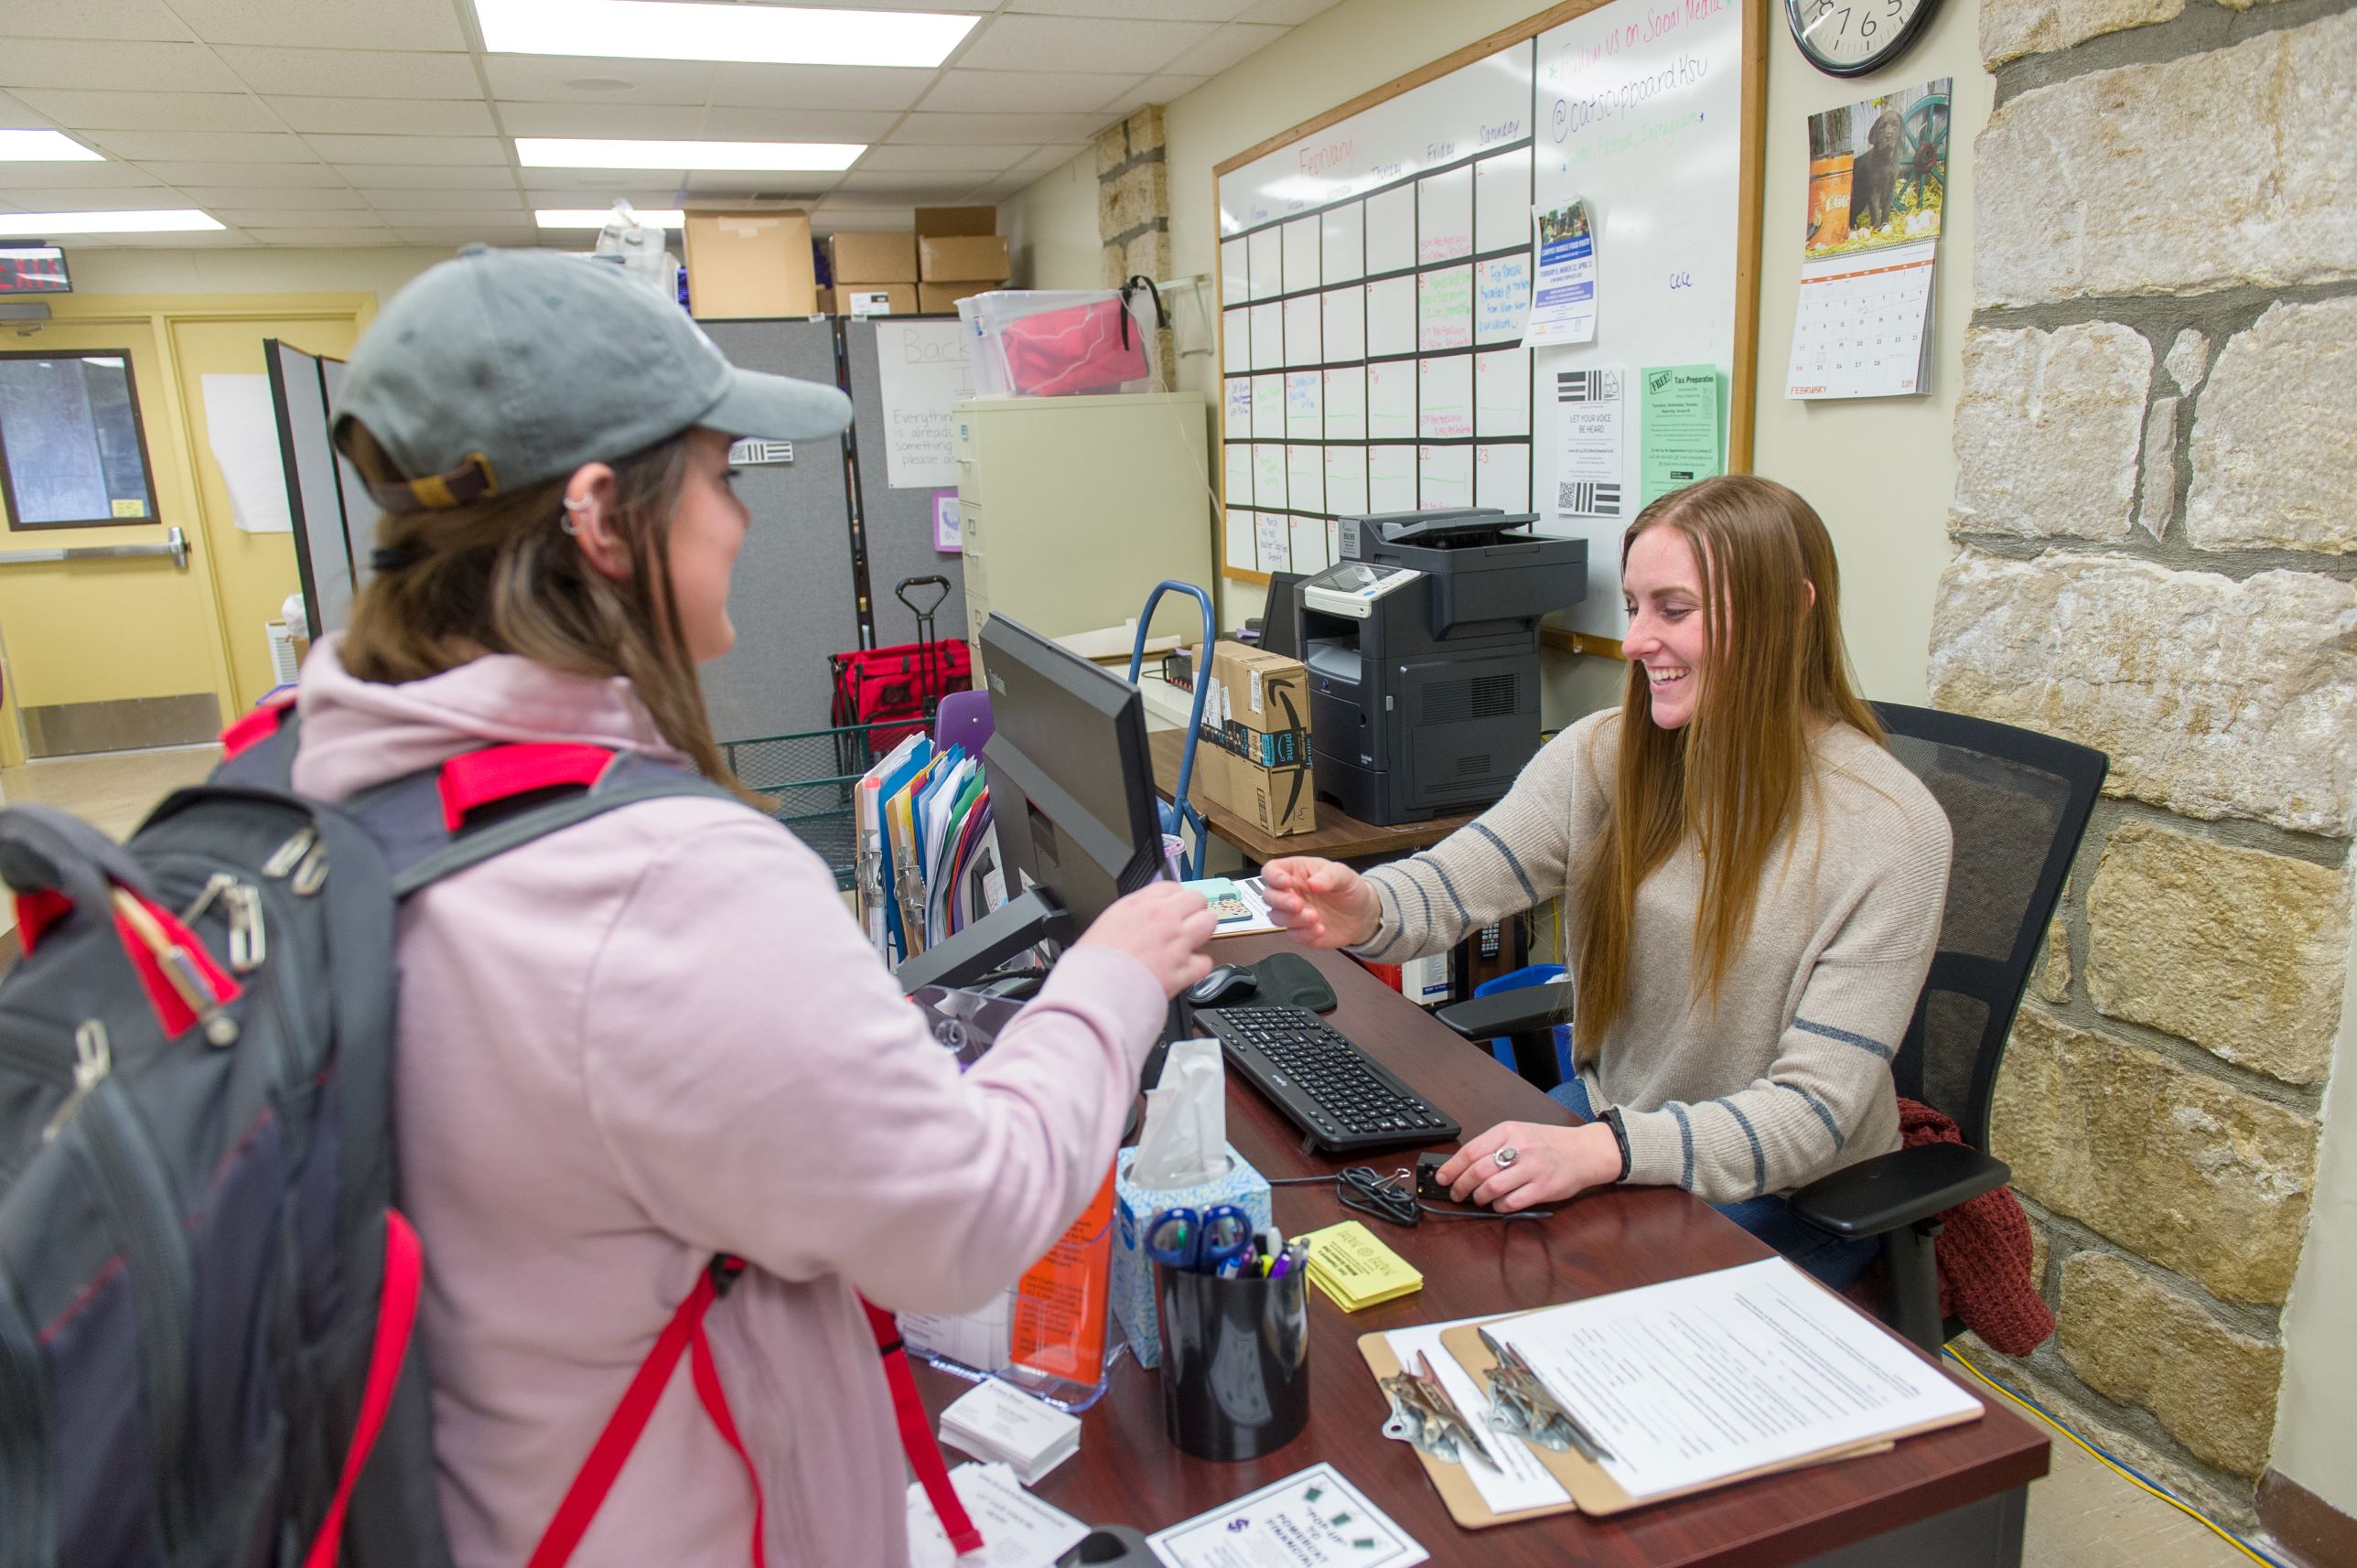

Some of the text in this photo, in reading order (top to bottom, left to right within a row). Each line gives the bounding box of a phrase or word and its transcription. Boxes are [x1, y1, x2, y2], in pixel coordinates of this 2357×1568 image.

[1837, 7, 1851, 35] 7
[1861, 11, 1877, 37] 6
[1625, 24, 1639, 48] on
[1426, 142, 1456, 161] Friday
[1479, 119, 1521, 147] Saturday
[903, 326, 970, 361] Back
[1651, 371, 1713, 392] FREE! Tax Preparation
[1791, 385, 1826, 394] FEBRUARY
[1569, 413, 1611, 423] LET YOUR VOICE
[1578, 424, 1604, 434] BE HEARD
[895, 438, 952, 455] something
[1419, 446, 1430, 460] 22
[1478, 447, 1490, 464] 23
[902, 451, 938, 469] please
[1284, 733, 1294, 761] prime
